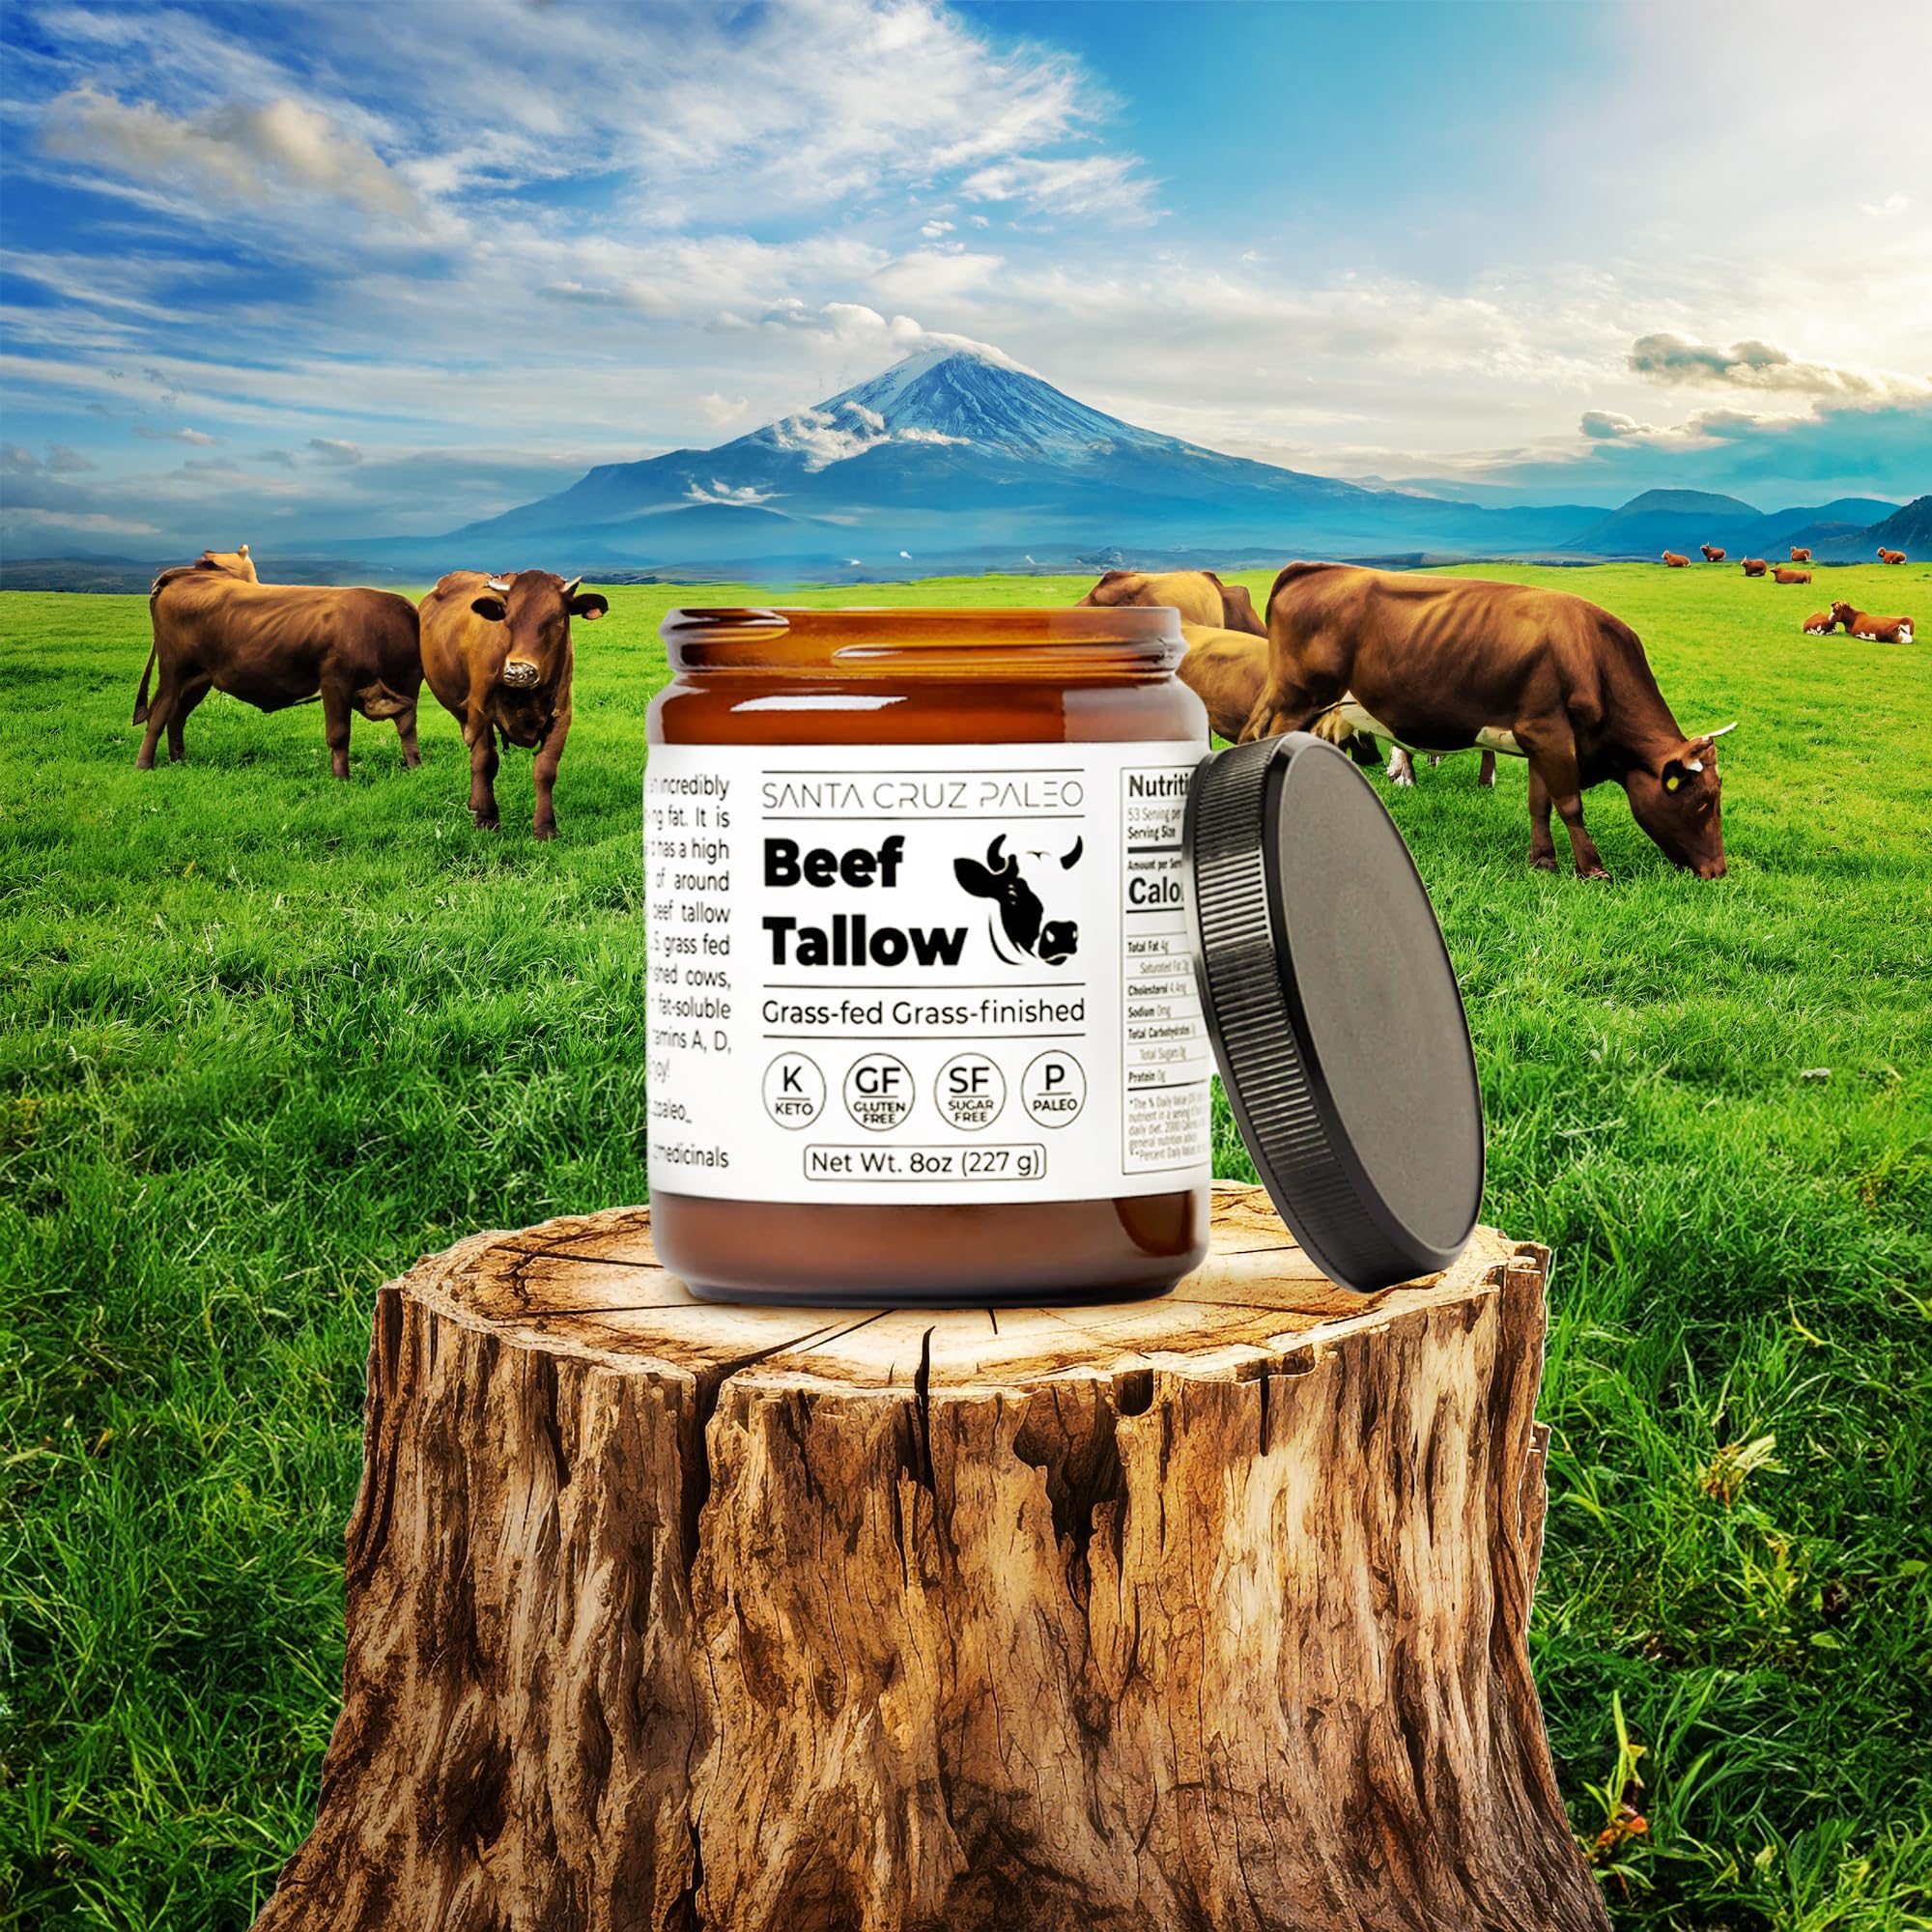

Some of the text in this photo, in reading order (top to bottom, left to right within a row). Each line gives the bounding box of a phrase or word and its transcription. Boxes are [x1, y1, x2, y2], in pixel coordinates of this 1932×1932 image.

[761, 781, 1084, 810] SANTA CRUZ PALEO
[696, 807, 707, 827] It
[716, 806, 730, 828] is
[1128, 826, 1159, 841] Serving
[679, 842, 687, 858] a
[692, 837, 730, 865] high
[763, 835, 905, 888] Beef
[674, 870, 730, 892] around
[1128, 876, 1184, 905] Calo
[682, 901, 730, 923] tallow
[703, 933, 730, 955] fed
[762, 914, 969, 967] Tallow
[1128, 941, 1146, 952] Total
[1149, 940, 1159, 952] Fat
[686, 969, 732, 990] cows,
[762, 998, 1085, 1026] Grass-fed Grass-finished
[692, 1030, 707, 1053] A,
[714, 1031, 731, 1055] D,
[782, 1065, 803, 1094] K
[855, 1066, 901, 1094] GF
[949, 1066, 990, 1094] SF
[1045, 1065, 1065, 1092] P
[775, 1102, 813, 1117] KETO
[853, 1101, 906, 1114] GLUTEN
[947, 1099, 994, 1112] SUGAR
[1033, 1097, 1077, 1112] PALEO
[863, 1113, 896, 1124] FREE
[953, 1111, 988, 1122] FREE
[811, 1150, 1040, 1177] Net Wt. 8oz (227 g)
